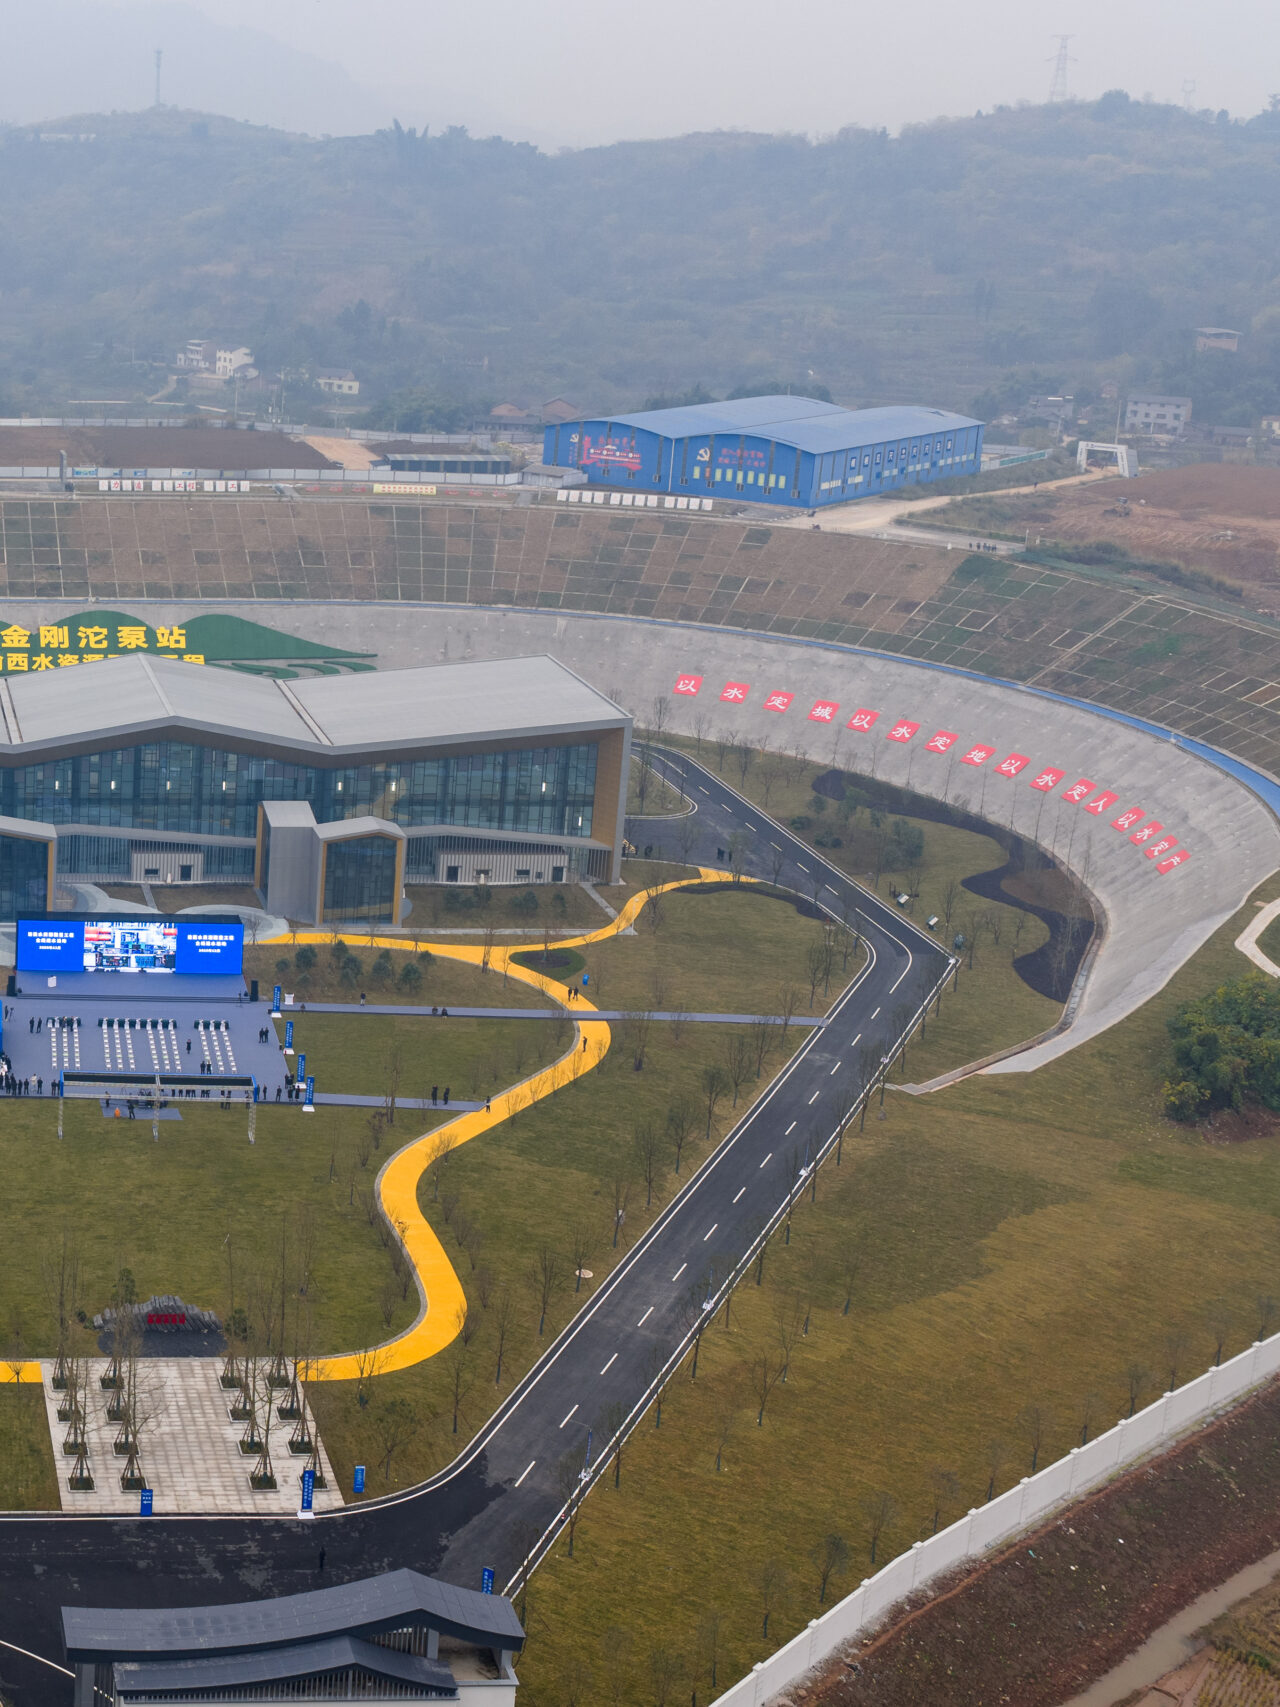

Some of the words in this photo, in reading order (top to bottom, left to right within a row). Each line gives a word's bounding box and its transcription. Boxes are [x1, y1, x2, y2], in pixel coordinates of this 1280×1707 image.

[0, 625, 187, 649] 金刚沱泵站
